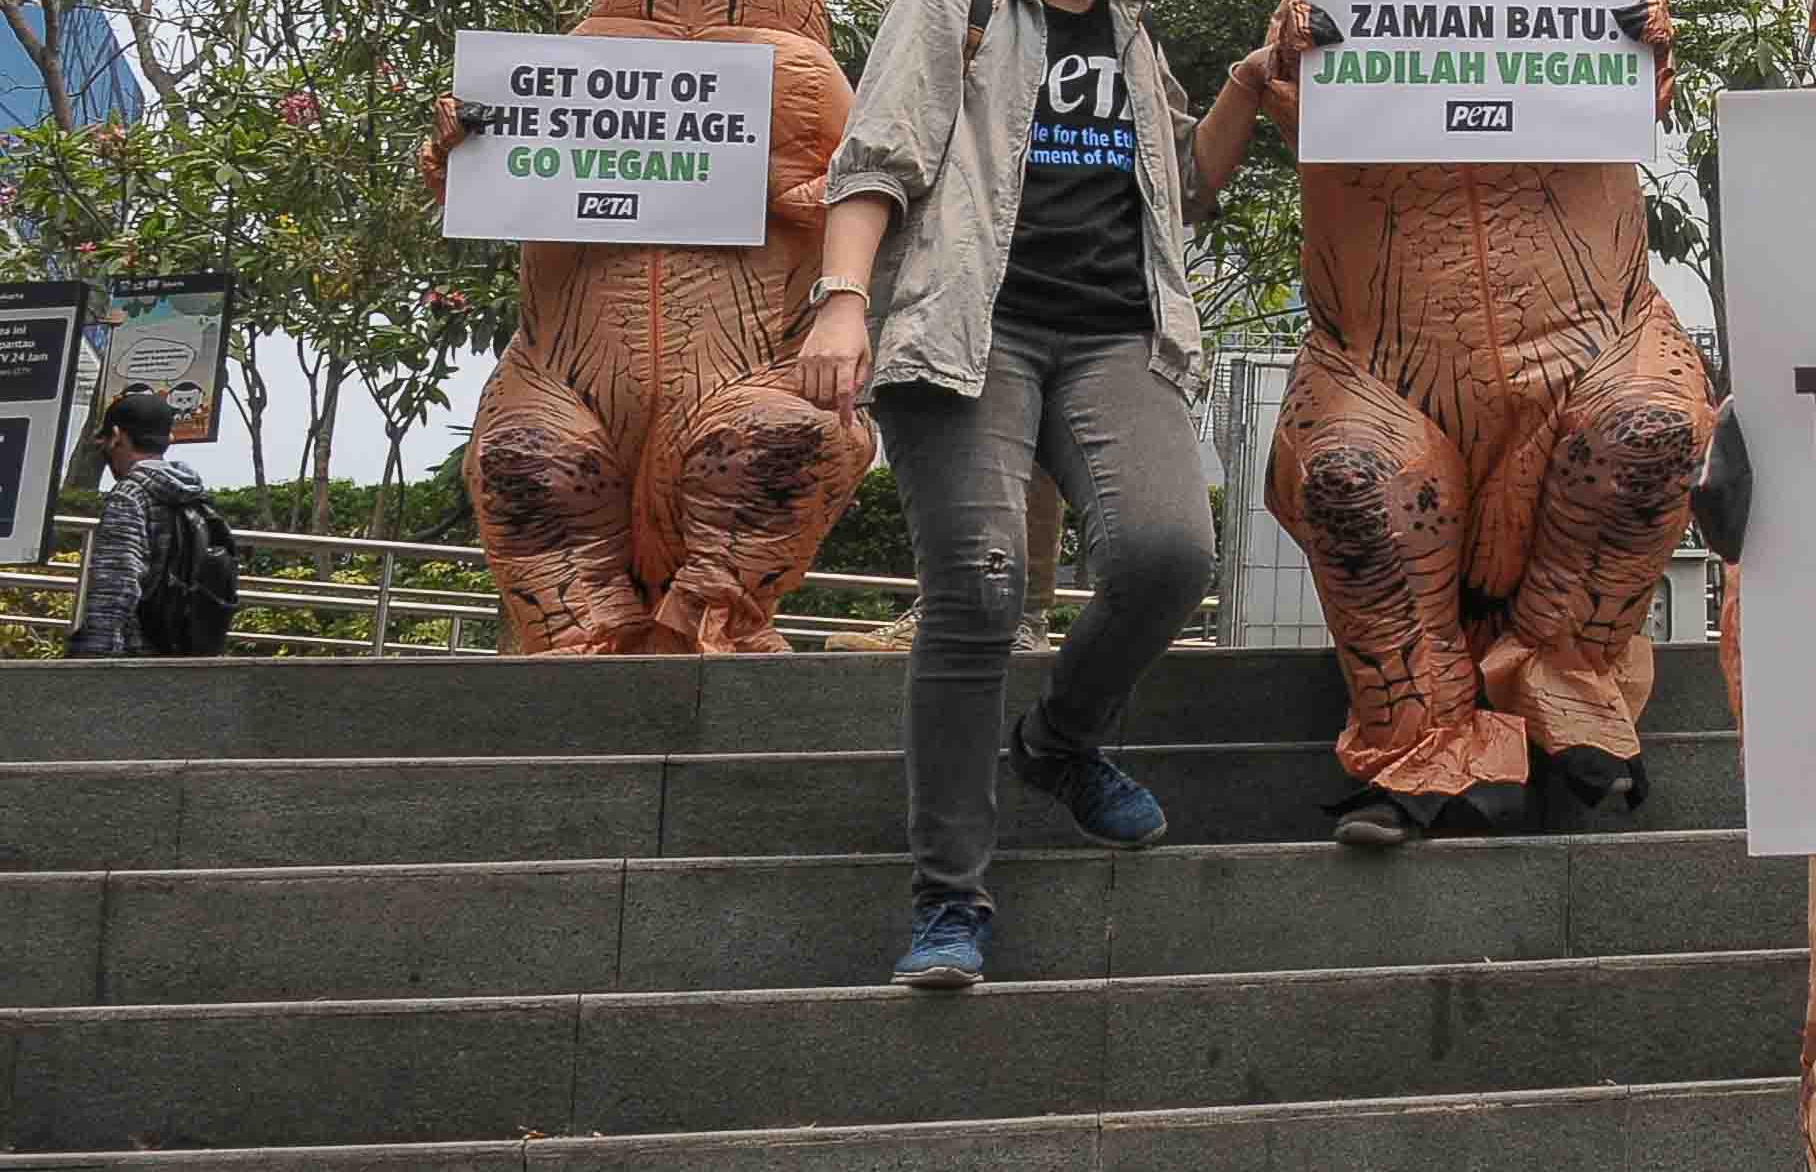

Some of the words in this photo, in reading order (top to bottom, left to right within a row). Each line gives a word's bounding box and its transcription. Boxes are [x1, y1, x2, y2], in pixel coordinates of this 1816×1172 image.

[1350, 4, 1494, 39] ZAMAN
[1506, 6, 1619, 41] BATU.
[510, 65, 579, 98] GET
[586, 68, 663, 102] OUT
[671, 72, 718, 103] OF
[1313, 50, 1486, 85] JADILAH
[1496, 51, 1639, 86] VEGAN!
[1040, 54, 1134, 121] eT
[478, 105, 540, 137] HE
[548, 108, 666, 141] STONE
[675, 112, 757, 145] AGE.
[1451, 106, 1508, 128] PeTA
[1054, 125, 1077, 146] for
[1082, 128, 1109, 146] the
[507, 145, 561, 178] GO
[570, 148, 711, 183] VEGAN!
[1084, 150, 1102, 165] of
[582, 196, 634, 216] PeTA
